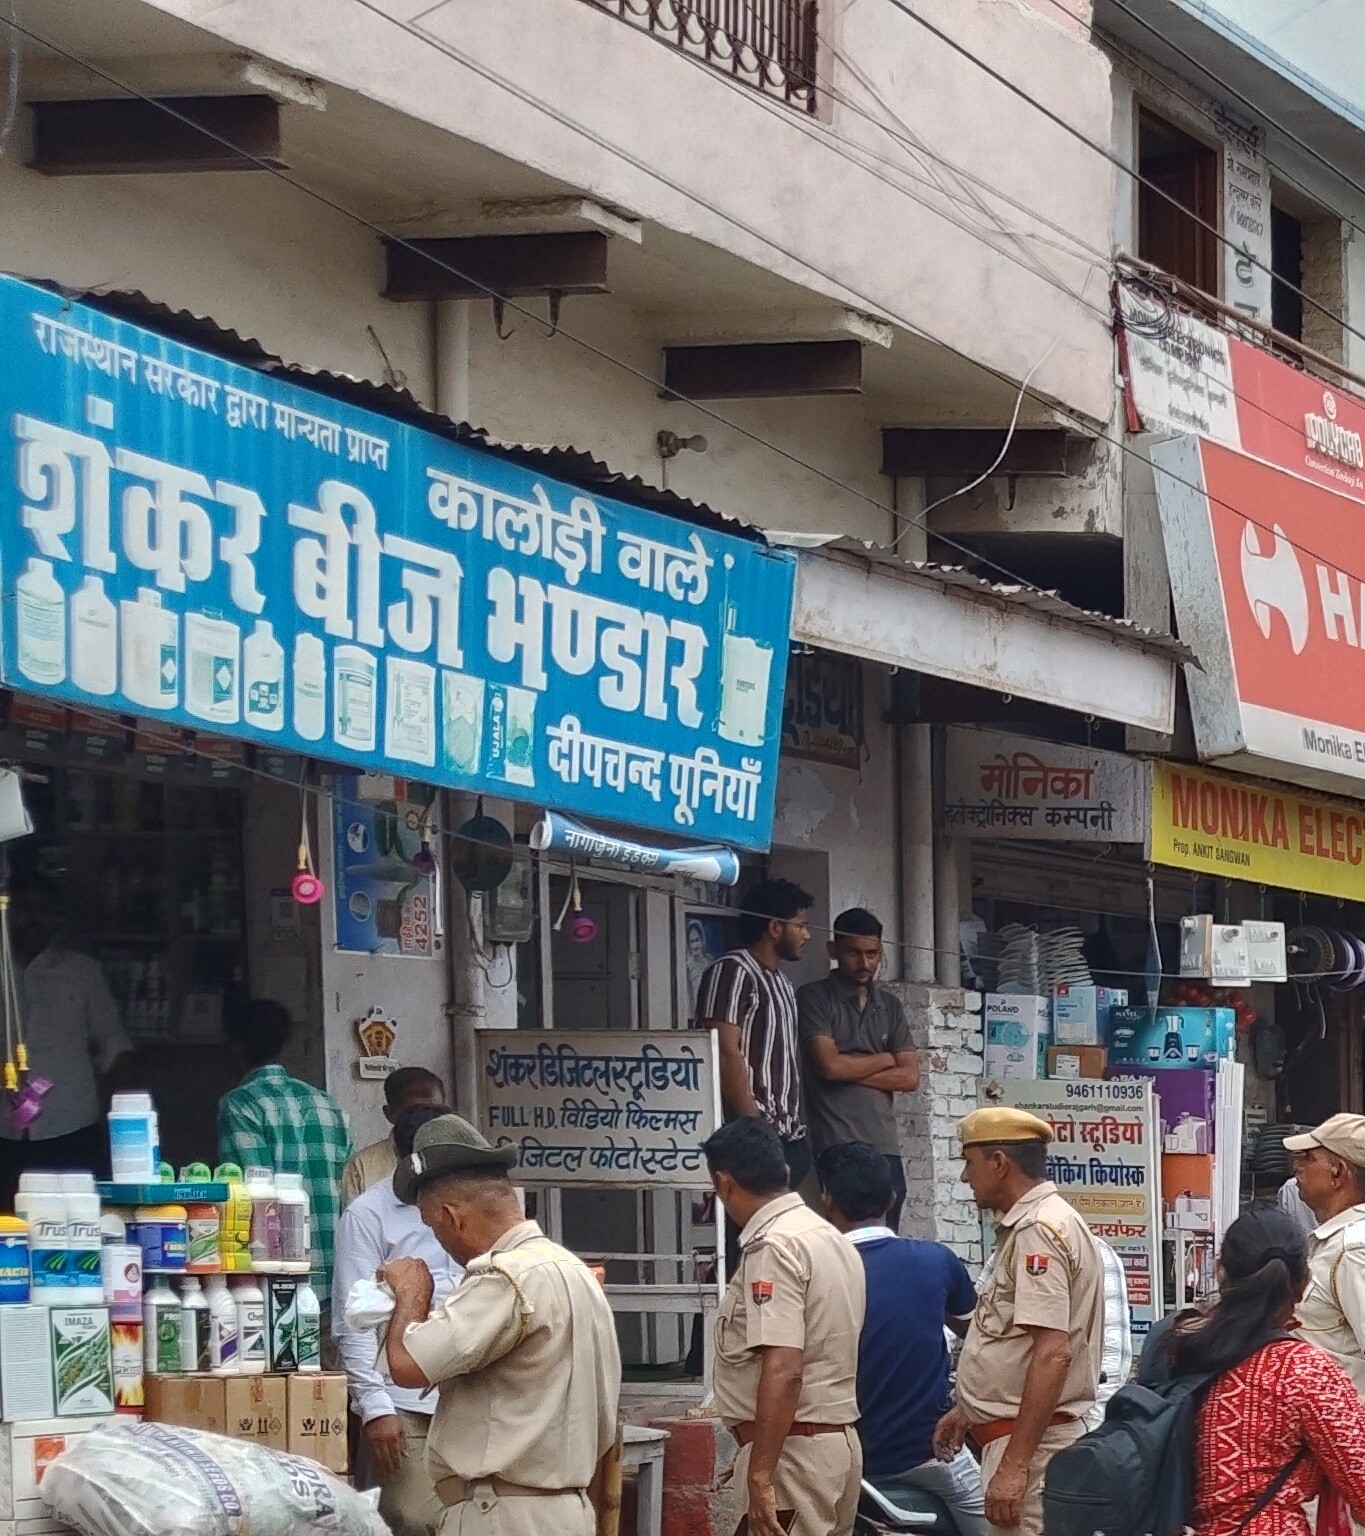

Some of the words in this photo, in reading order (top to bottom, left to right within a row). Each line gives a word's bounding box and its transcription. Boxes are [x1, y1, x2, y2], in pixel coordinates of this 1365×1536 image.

[32, 313, 138, 385] राजस्थान
[142, 355, 221, 416] सरकार
[223, 384, 269, 430] द्वारा
[271, 400, 342, 456] मान्यता
[345, 426, 390, 472] प्राप्त
[426, 466, 607, 586] कालोड़ी
[616, 531, 715, 606] वाले
[14, 394, 268, 614] शंकर
[287, 479, 464, 670] बीज
[486, 567, 710, 730] भण्डार
[1303, 727, 1353, 761] Monika
[546, 714, 666, 802] दीपचन्द
[669, 746, 763, 827] पूनियाँ
[980, 751, 1094, 800] मोनिका
[1045, 801, 1117, 831] कम्पनी
[1171, 773, 1291, 851] MONIKA
[1192, 844, 1214, 862] ANKIT
[414, 895, 428, 951] 4252
[1066, 1083, 1144, 1100] 9461110936
[489, 1106, 528, 1128] FULL
[560, 1098, 623, 1130] विडियो
[1079, 1115, 1144, 1153] स्टूडियो
[1088, 1156, 1146, 1187] कियोस्क
